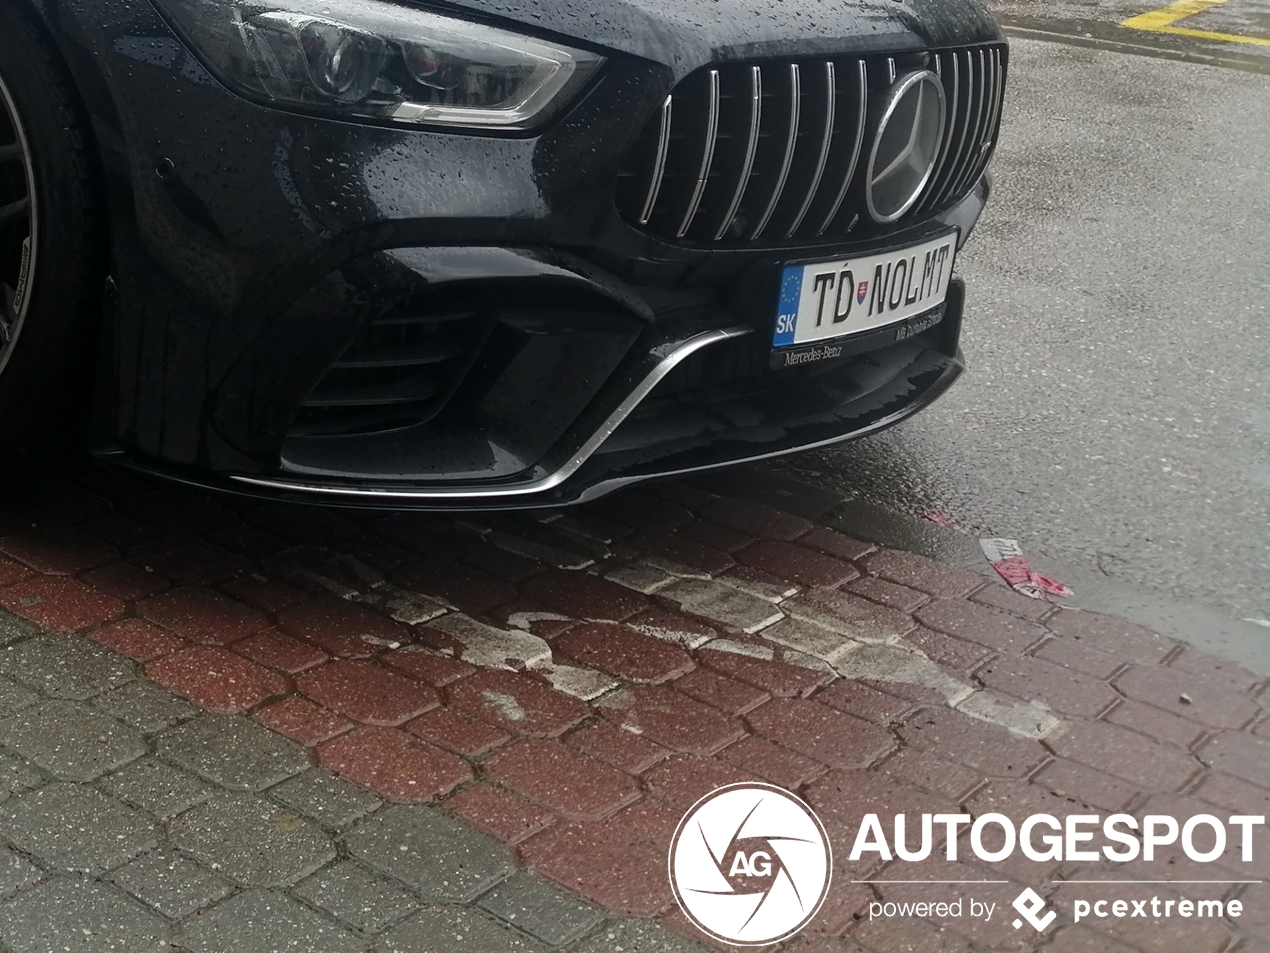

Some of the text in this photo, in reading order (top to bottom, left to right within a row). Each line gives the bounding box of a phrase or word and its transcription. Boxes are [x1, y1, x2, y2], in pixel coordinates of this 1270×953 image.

[868, 244, 950, 318] NOLMT
[776, 314, 796, 334] SK
[784, 347, 842, 367] Mercedes-Benz
